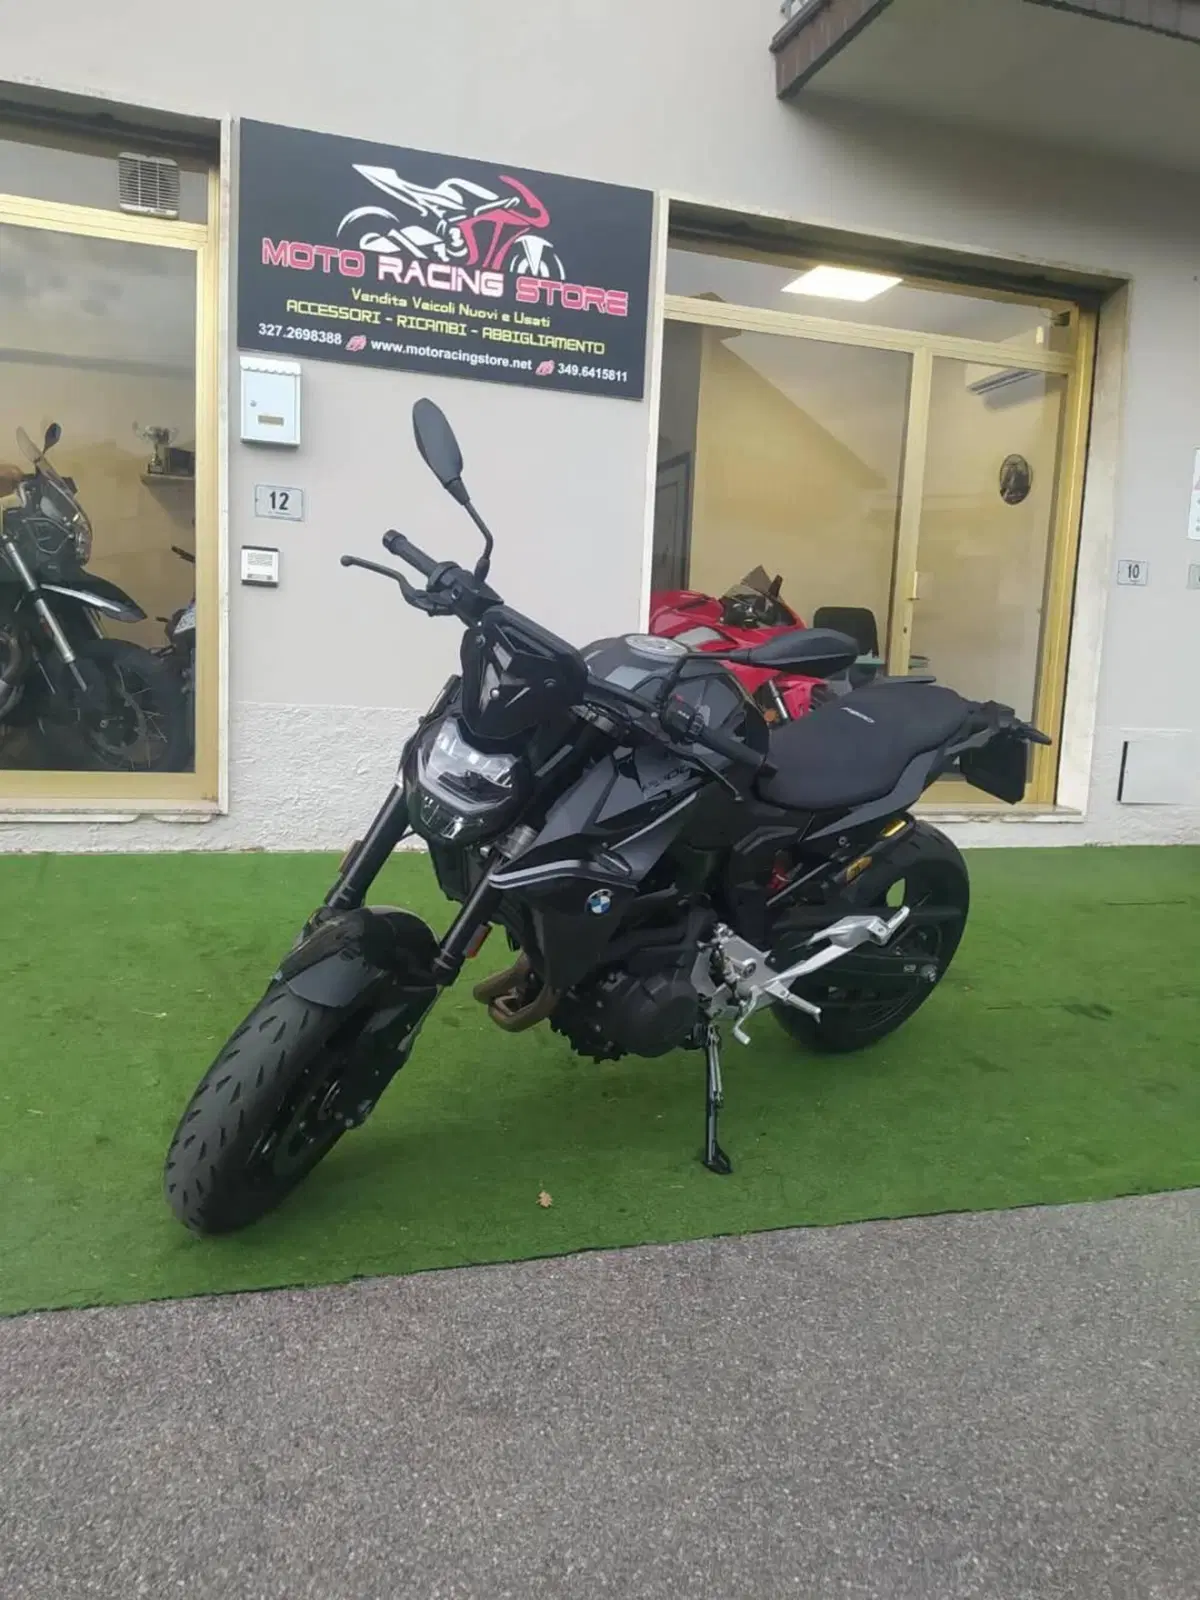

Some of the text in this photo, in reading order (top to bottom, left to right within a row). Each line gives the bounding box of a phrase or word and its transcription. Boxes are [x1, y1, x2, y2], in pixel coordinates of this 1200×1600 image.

[262, 237, 629, 317] MOTO RACING STORE
[286, 299, 381, 324] ACCESSORI
[397, 314, 467, 337] RICAMBI
[482, 326, 605, 355] ABBIGLIAMENTO
[351, 287, 551, 328] Vendita Veicoli Nuovi e Usati
[258, 323, 628, 382] 327.2698388 www.motoracingstore.net 349.6415811
[269, 491, 290, 511] 12
[1127, 564, 1140, 579] 10
